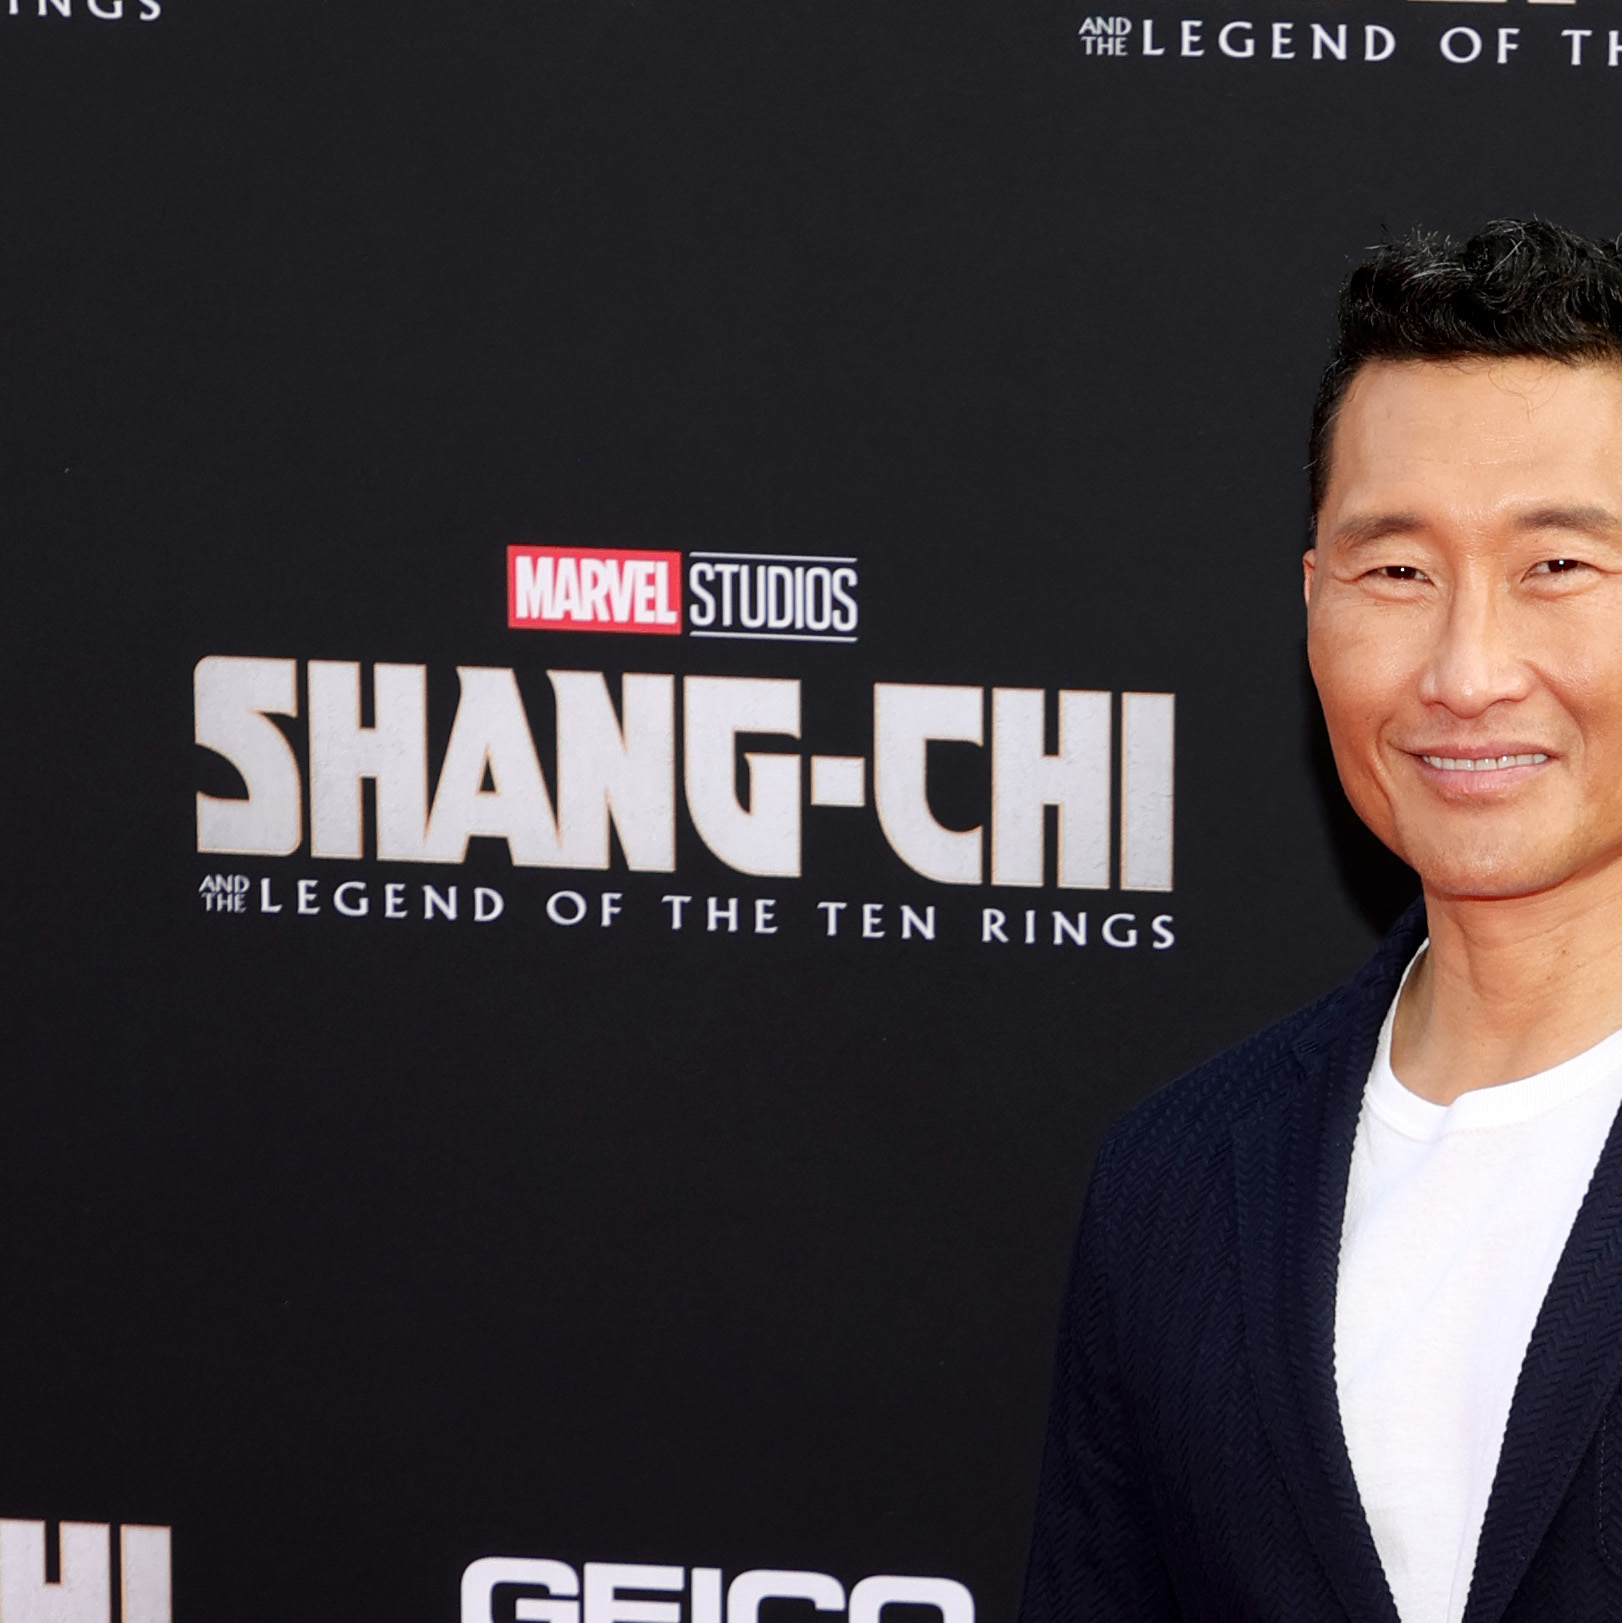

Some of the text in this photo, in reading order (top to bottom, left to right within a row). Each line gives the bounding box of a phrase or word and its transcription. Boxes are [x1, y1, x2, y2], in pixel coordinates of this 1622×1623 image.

[1078, 16, 1133, 36] AND
[1142, 19, 1396, 62] LEGEND
[1439, 26, 1521, 64] OF
[1080, 36, 1128, 56] THE
[514, 554, 858, 632] MARVEL STUDIOS
[193, 655, 1176, 893] SHANG-CHI
[198, 874, 250, 894] AND
[201, 892, 247, 913] THE
[260, 877, 1176, 950] LEGEND OF THE TEN RINGS
